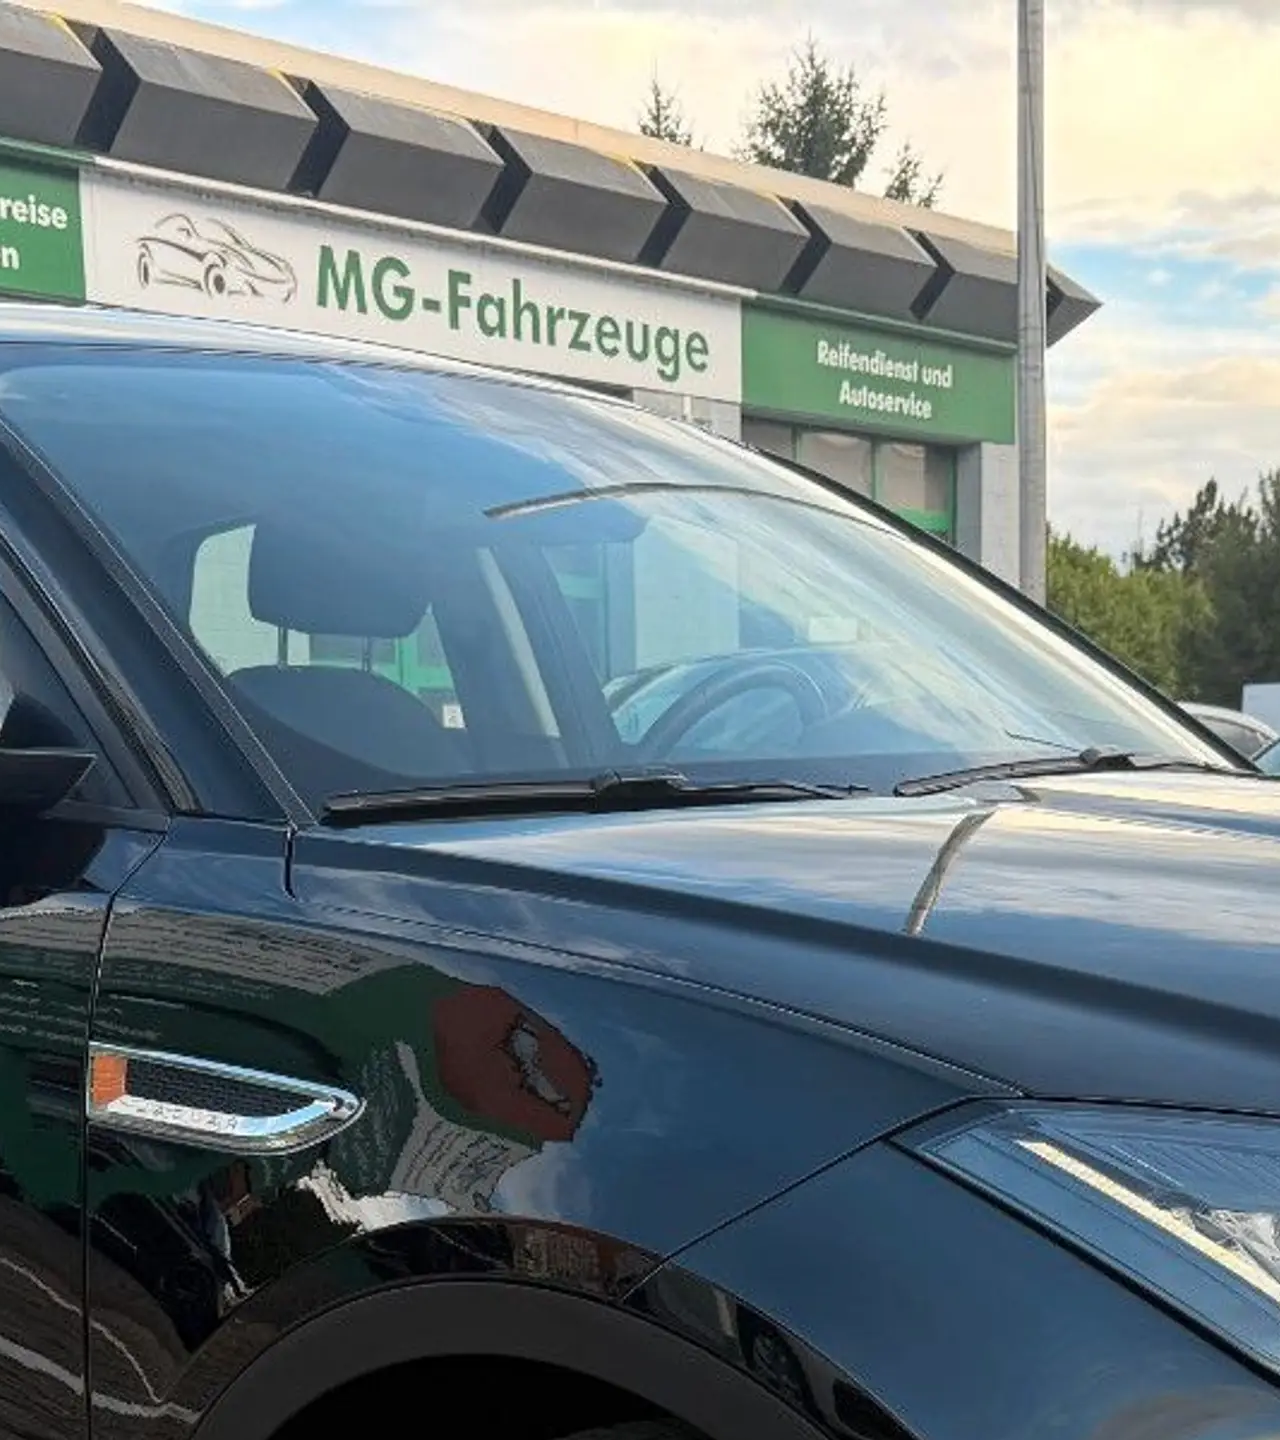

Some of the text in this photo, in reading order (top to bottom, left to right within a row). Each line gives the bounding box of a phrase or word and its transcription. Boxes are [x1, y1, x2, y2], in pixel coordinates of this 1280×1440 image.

[316, 244, 710, 382] MG-Fahrzeuge
[817, 339, 953, 388] Reifendienst und
[839, 379, 933, 420] Autoservice
